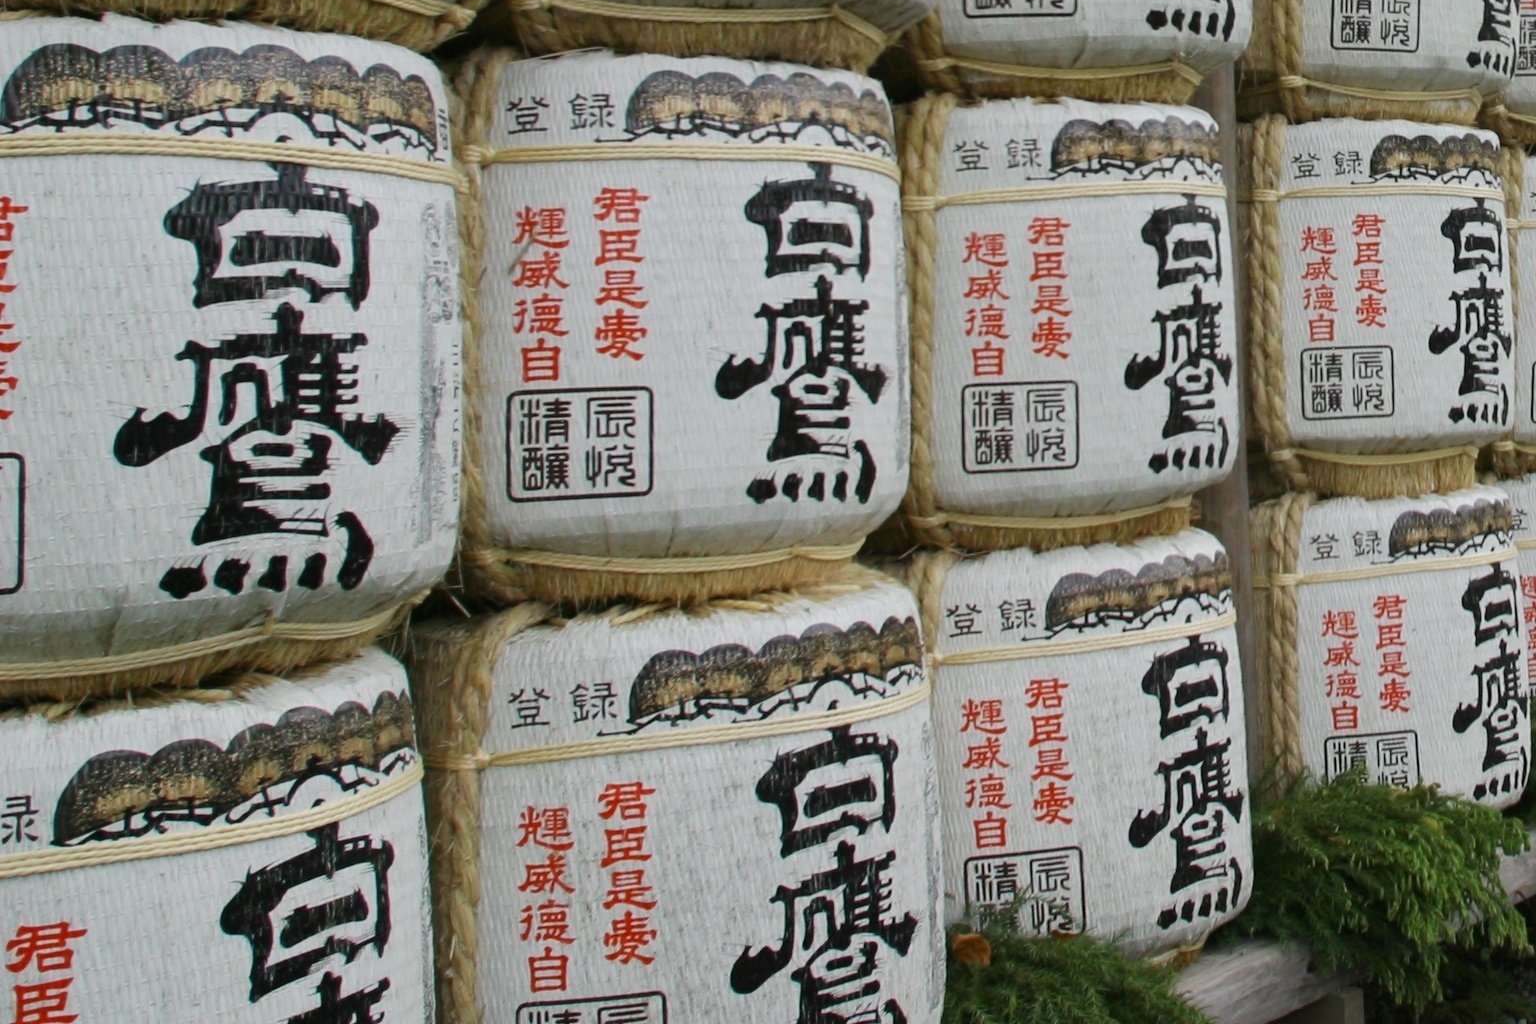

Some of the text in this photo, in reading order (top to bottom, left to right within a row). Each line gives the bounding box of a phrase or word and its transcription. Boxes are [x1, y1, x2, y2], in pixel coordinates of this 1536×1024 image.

[506, 93, 615, 135] 登録
[953, 139, 1042, 172] 登録
[1291, 151, 1364, 179] 登録
[114, 156, 402, 598] 白鷹
[715, 163, 892, 504] 白鷹
[1124, 193, 1233, 474] 白鷹
[1428, 197, 1512, 426] 白鷹
[946, 599, 1037, 637] 登録
[1310, 531, 1383, 560] 登録
[508, 681, 618, 729] 登録
[1129, 634, 1244, 929] 白鷹
[1452, 562, 1529, 800] 白鷹
[220, 820, 394, 1024] 白
[730, 722, 917, 1024] 白鷹
